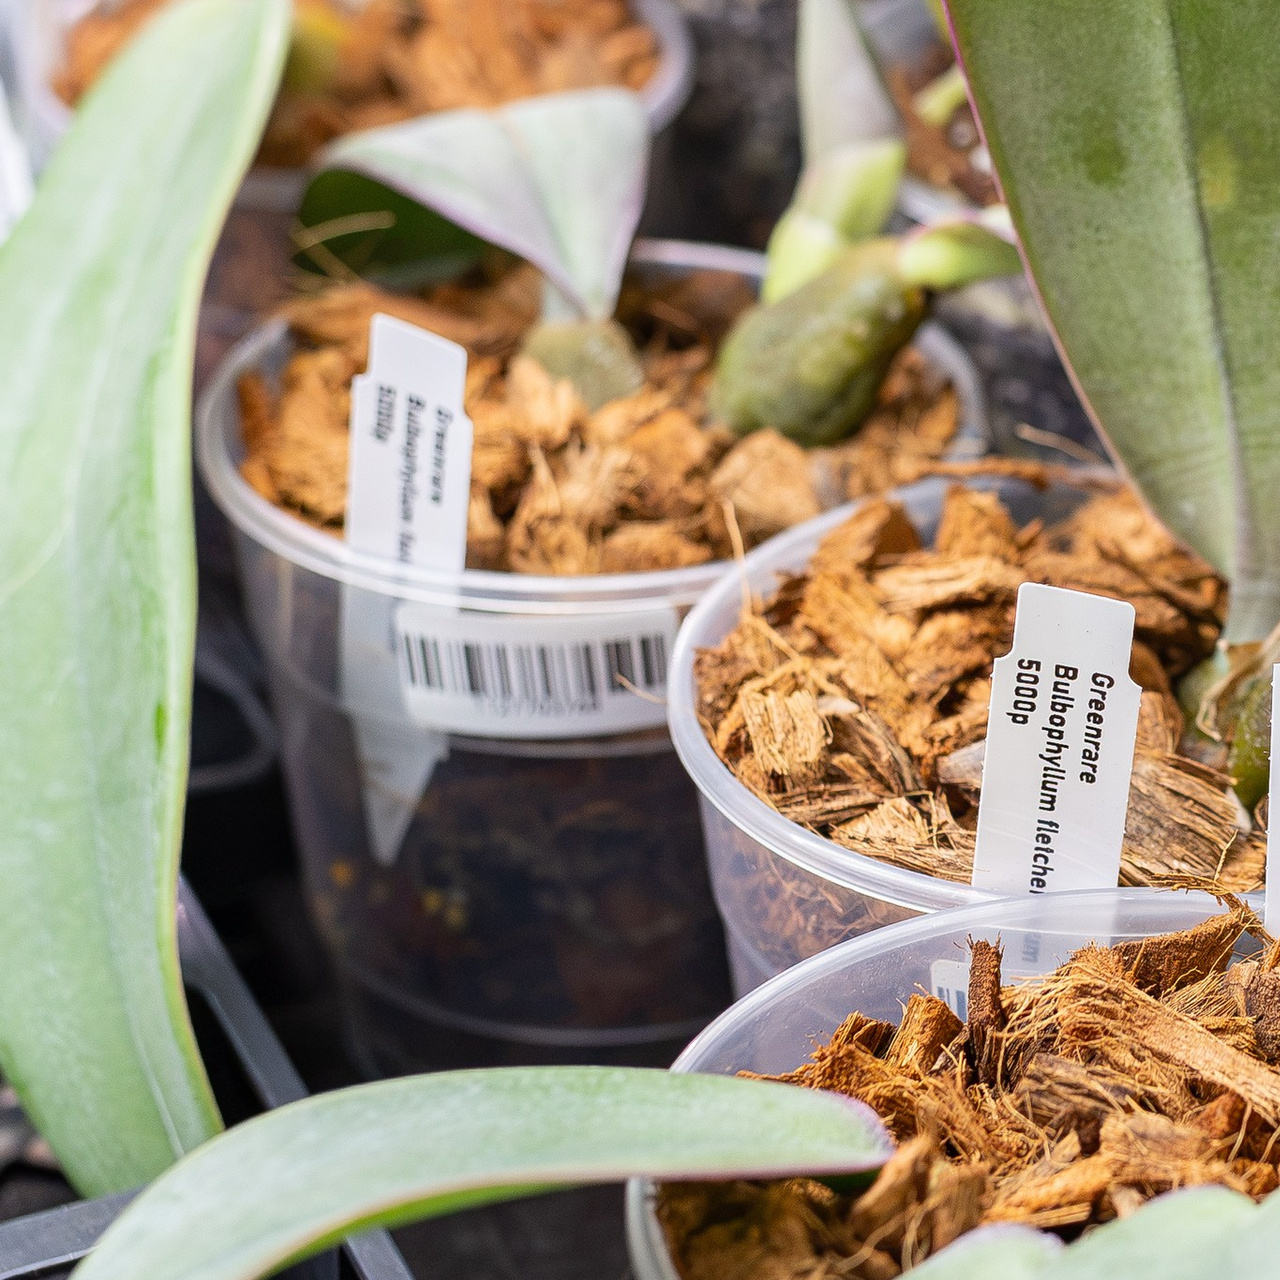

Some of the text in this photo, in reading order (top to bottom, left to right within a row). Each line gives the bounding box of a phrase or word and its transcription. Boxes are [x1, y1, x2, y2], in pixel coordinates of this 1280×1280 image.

[1006, 658, 1041, 725] 5000p
[1038, 664, 1078, 812] Bulbophyllum
[1079, 672, 1115, 785] Greenrare
